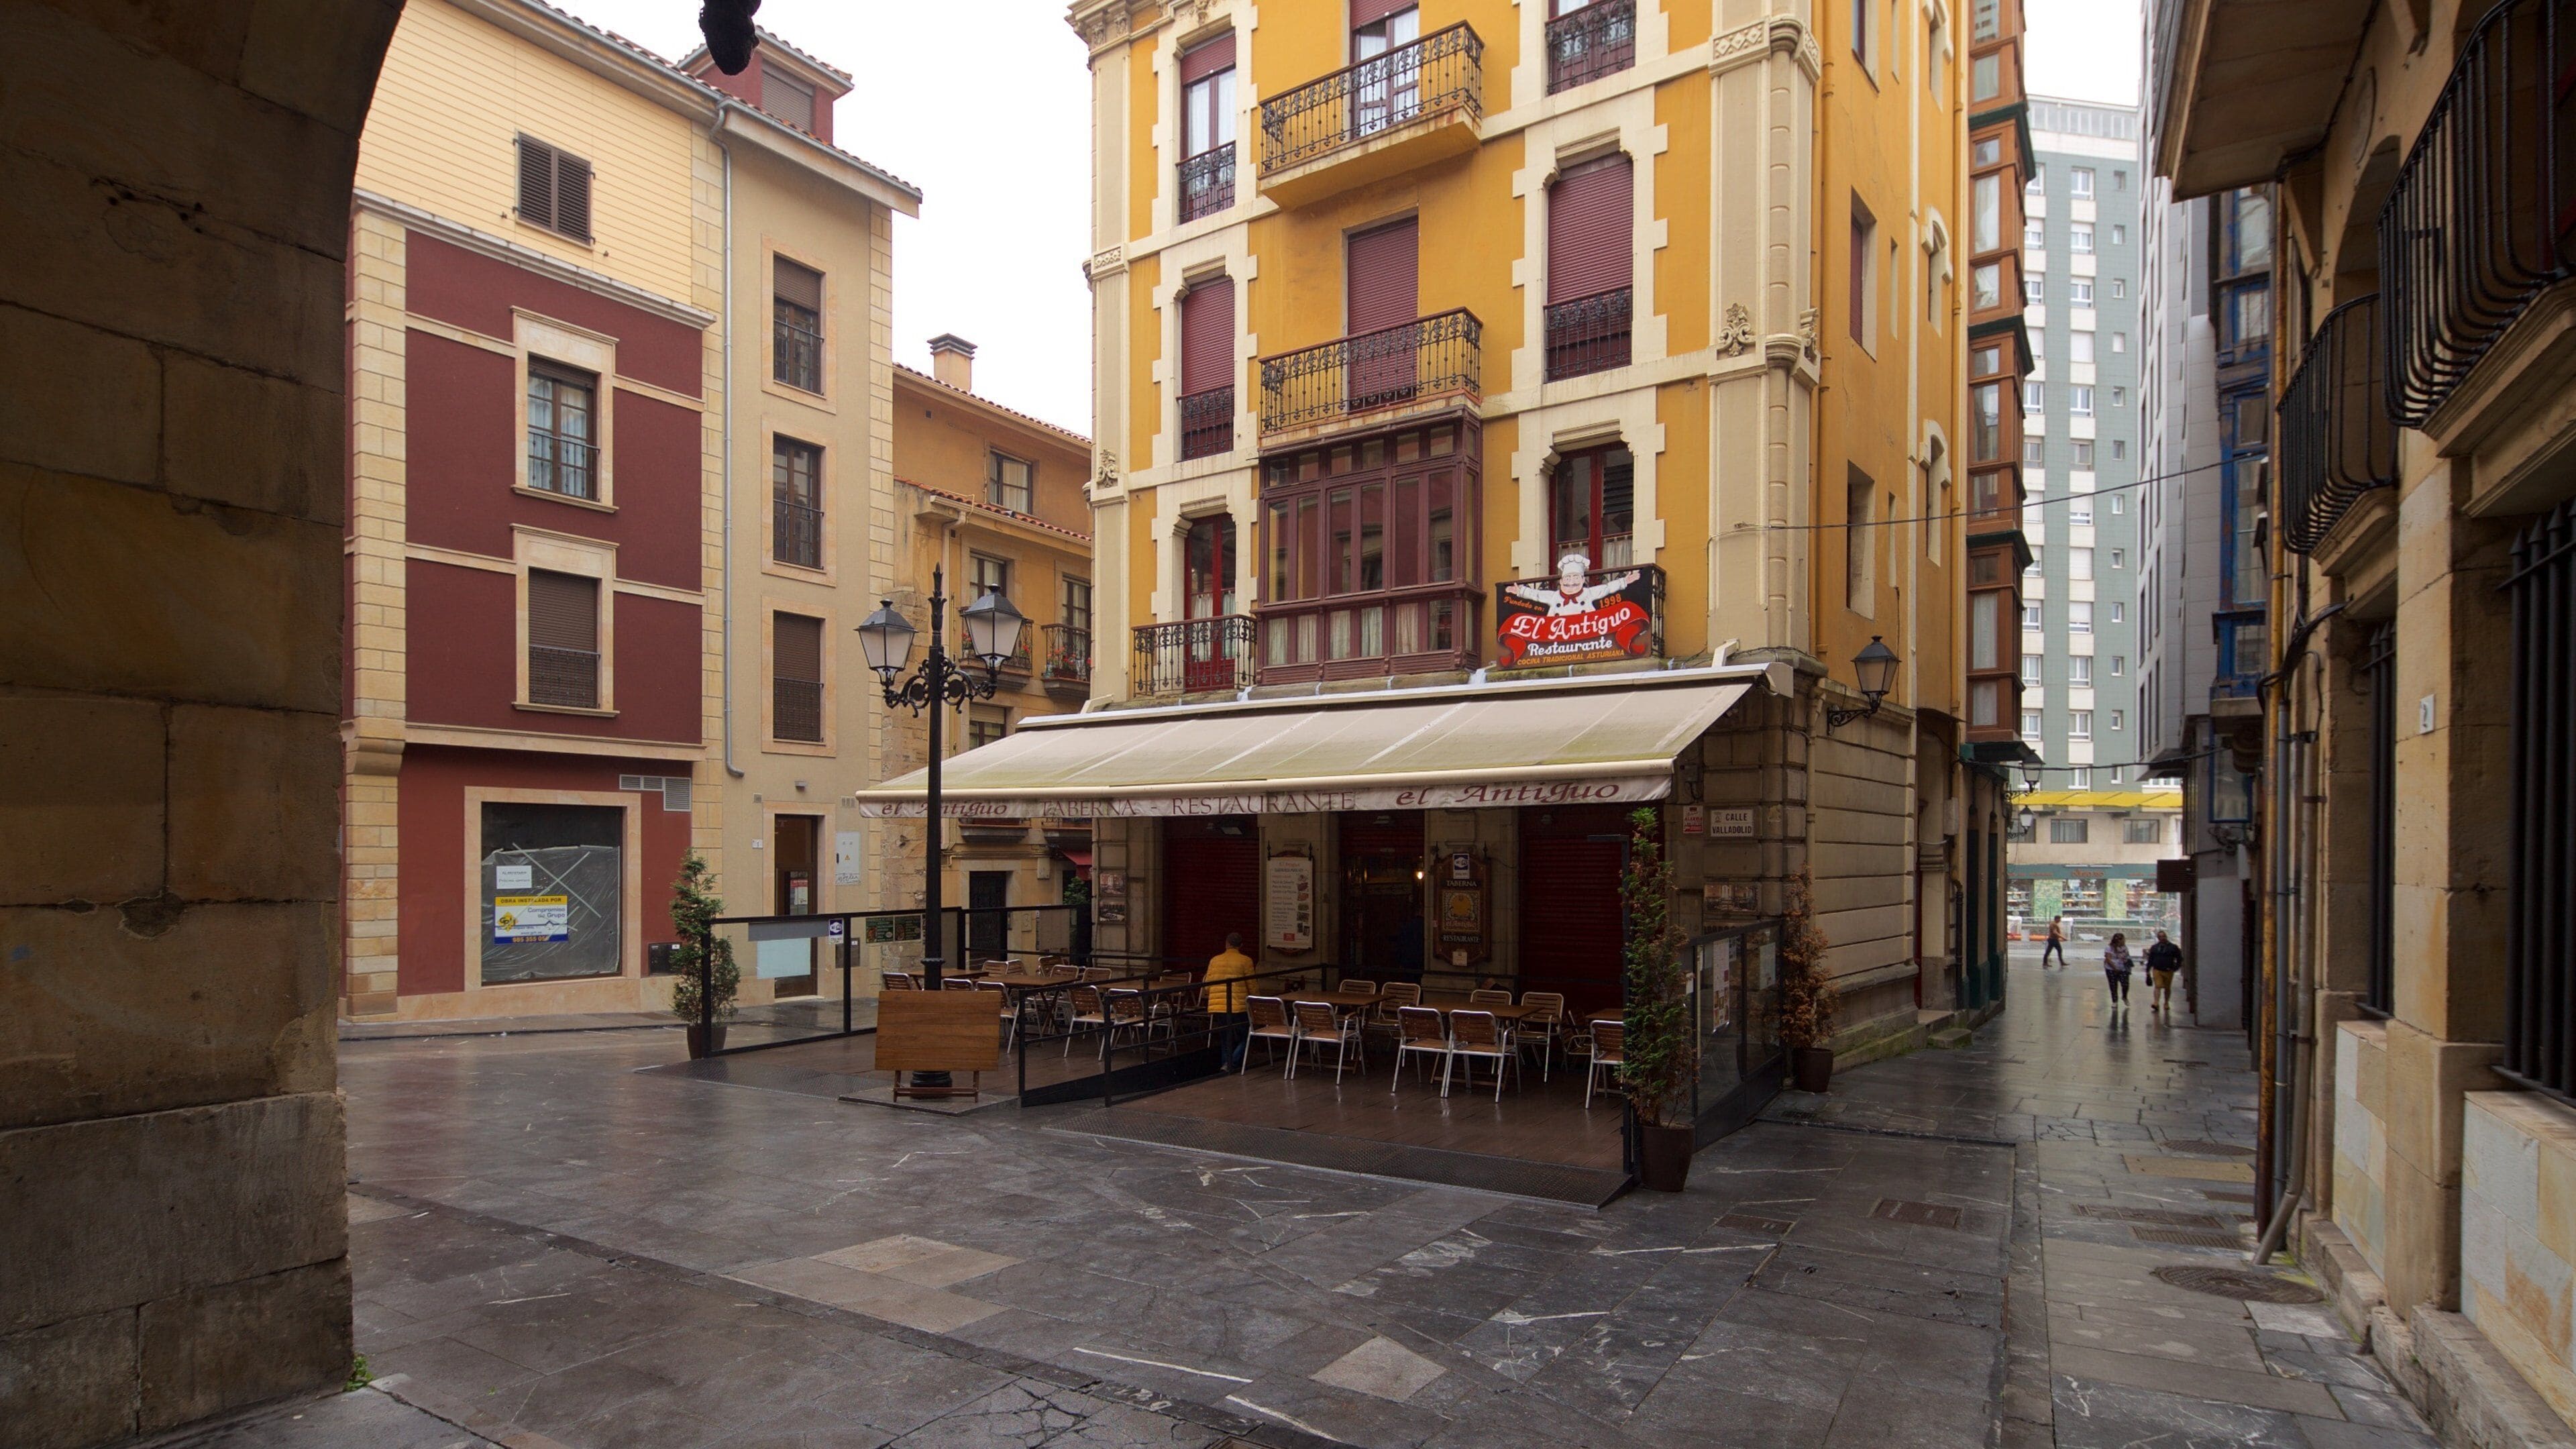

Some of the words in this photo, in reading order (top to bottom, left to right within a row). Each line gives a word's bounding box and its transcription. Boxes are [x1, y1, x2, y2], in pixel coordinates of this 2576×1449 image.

[1599, 594, 1622, 609] 1998
[1510, 615, 1545, 639] El
[1527, 636, 1613, 656] Restaurante
[1542, 655, 1584, 663] TRADICIONAL
[1587, 649, 1625, 659] ASTURIANA
[881, 802, 902, 816] el
[1040, 799, 1137, 817] TABERNA
[1172, 791, 1355, 816] RESTAURANTE
[1396, 787, 1433, 806] el
[1455, 782, 1619, 804] Antiguo
[1725, 813, 1748, 821] CALLE
[1712, 825, 1752, 834] VALLADOLID
[1443, 934, 1481, 943] RESTAURANTE
